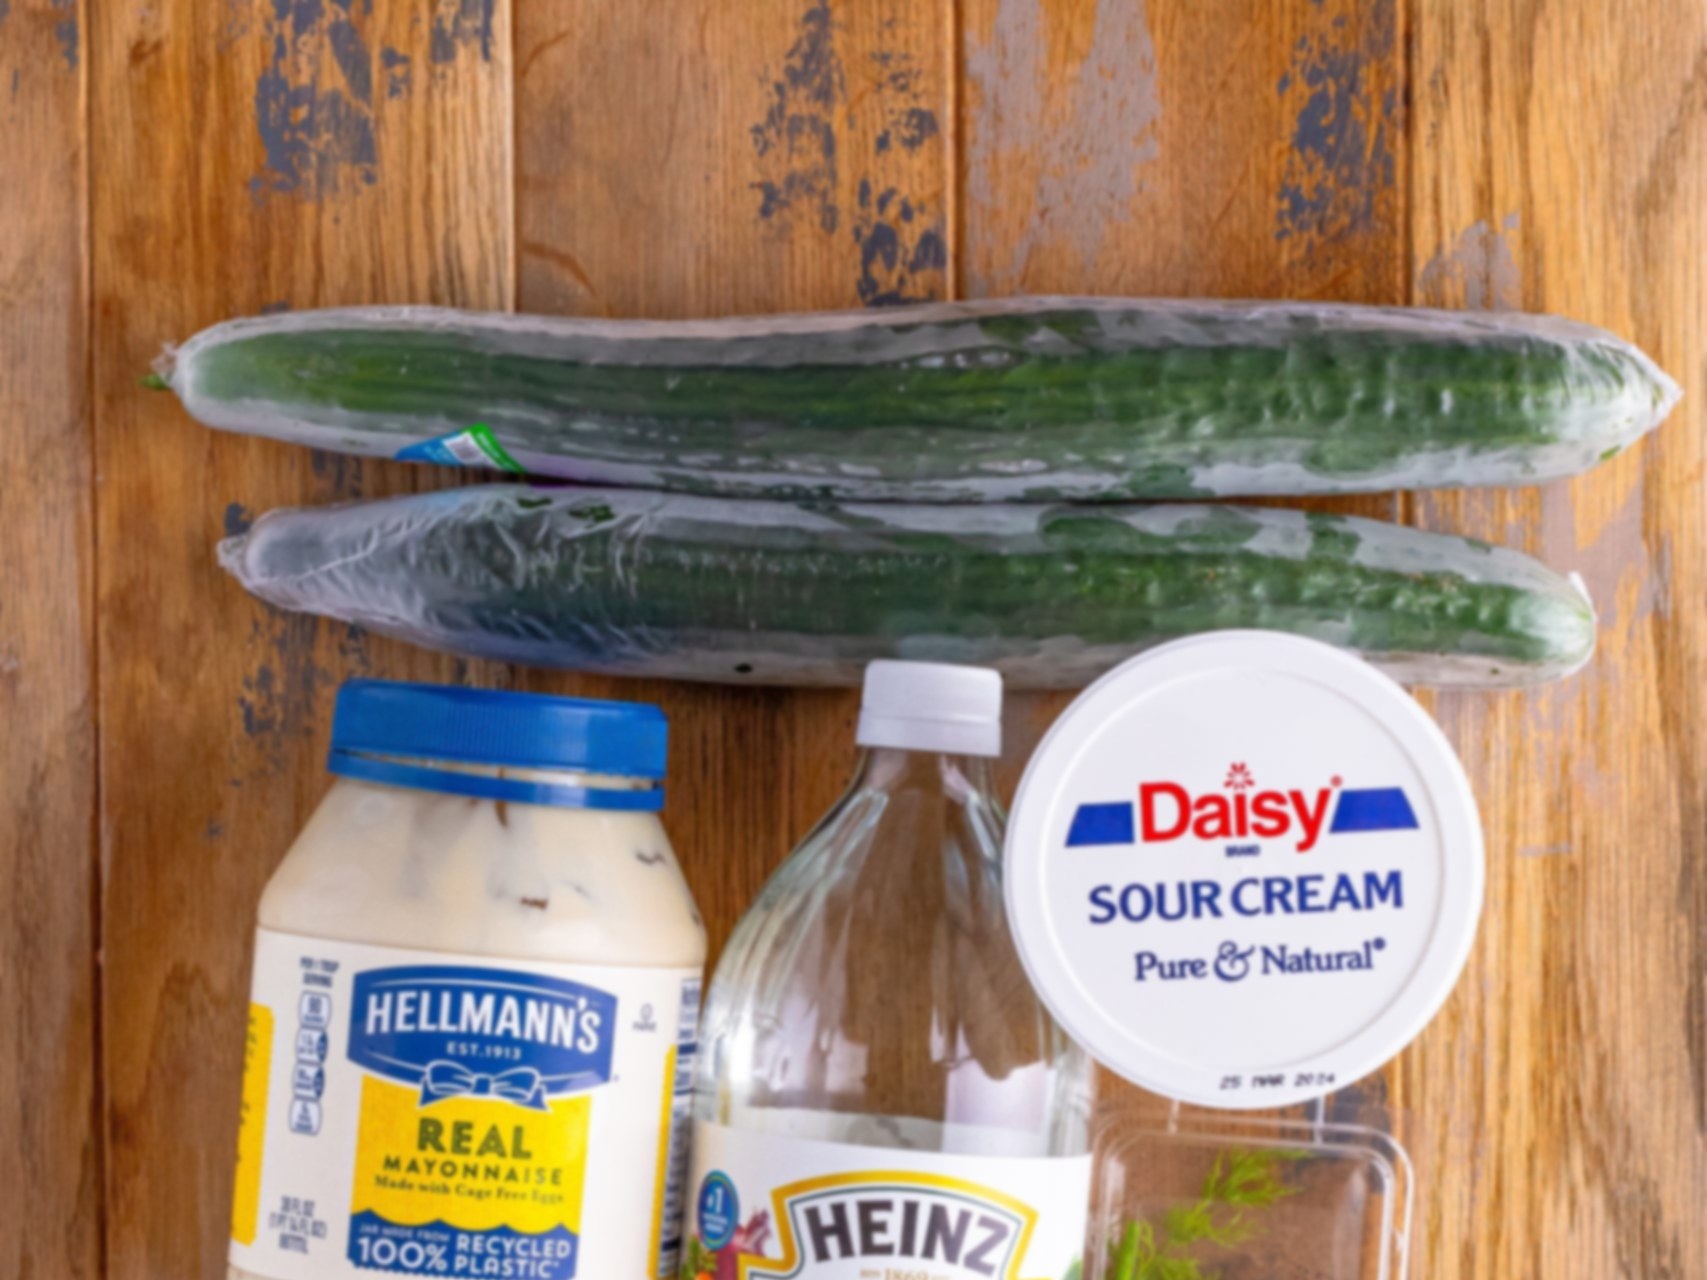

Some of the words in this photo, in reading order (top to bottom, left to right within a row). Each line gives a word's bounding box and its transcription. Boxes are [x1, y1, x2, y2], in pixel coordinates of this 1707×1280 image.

[1139, 775, 1332, 853] Daisy
[1225, 845, 1260, 858] BRAND
[1088, 881, 1222, 924] SOUR
[1230, 871, 1404, 917] CREAM
[1135, 951, 1207, 981] Pure
[1214, 941, 1254, 982] &
[365, 991, 601, 1054] HELLMANN'S
[1220, 1075, 1241, 1090] 25
[1252, 1073, 1285, 1089] MAR
[417, 1117, 533, 1159] REAL
[383, 1155, 564, 1185] MAYONNAISE
[374, 1175, 414, 1192] Made
[418, 1178, 451, 1195] with
[455, 1182, 493, 1201] Cage
[496, 1186, 527, 1201] Free
[531, 1189, 564, 1204] Eggs
[418, 1228, 450, 1242] FROM
[456, 1234, 571, 1258] RECYCLED
[803, 1199, 1009, 1277] HEINZ
[357, 1236, 448, 1271] 100%
